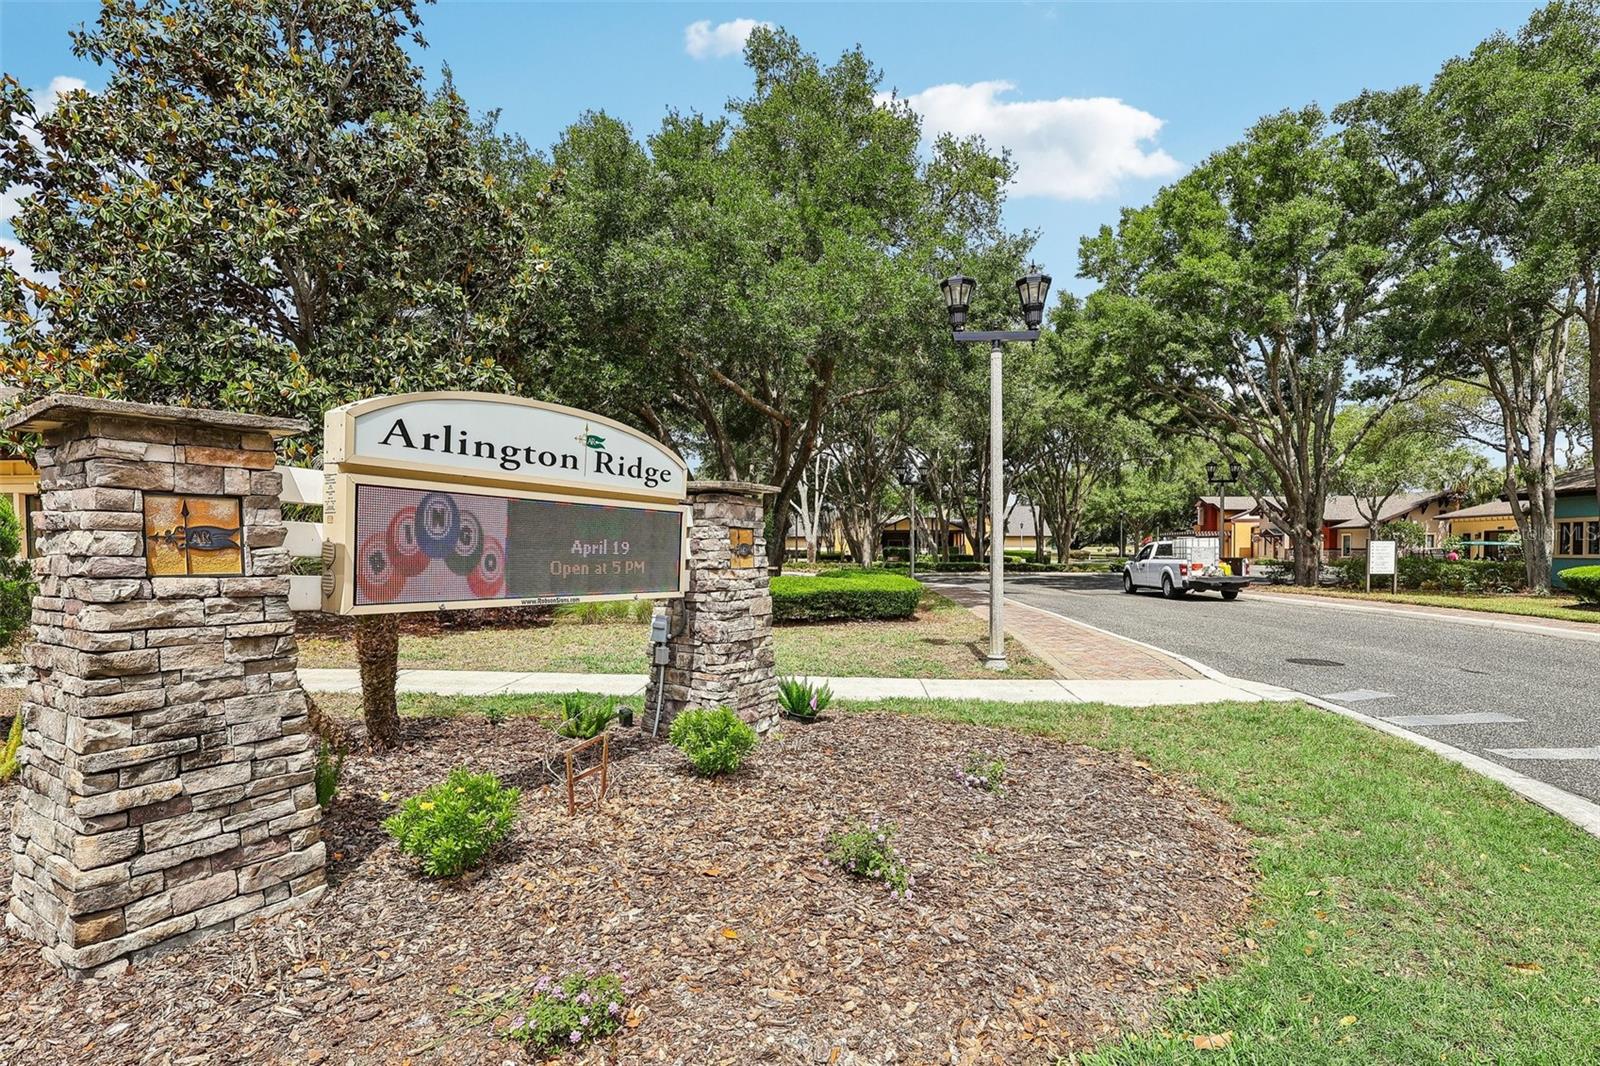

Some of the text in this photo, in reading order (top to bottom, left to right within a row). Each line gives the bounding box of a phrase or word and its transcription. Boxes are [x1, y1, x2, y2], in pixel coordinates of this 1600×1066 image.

[378, 418, 671, 488] Arlington Ridge
[571, 540, 630, 557] April 19
[550, 560, 645, 578] Open at 5 PM
